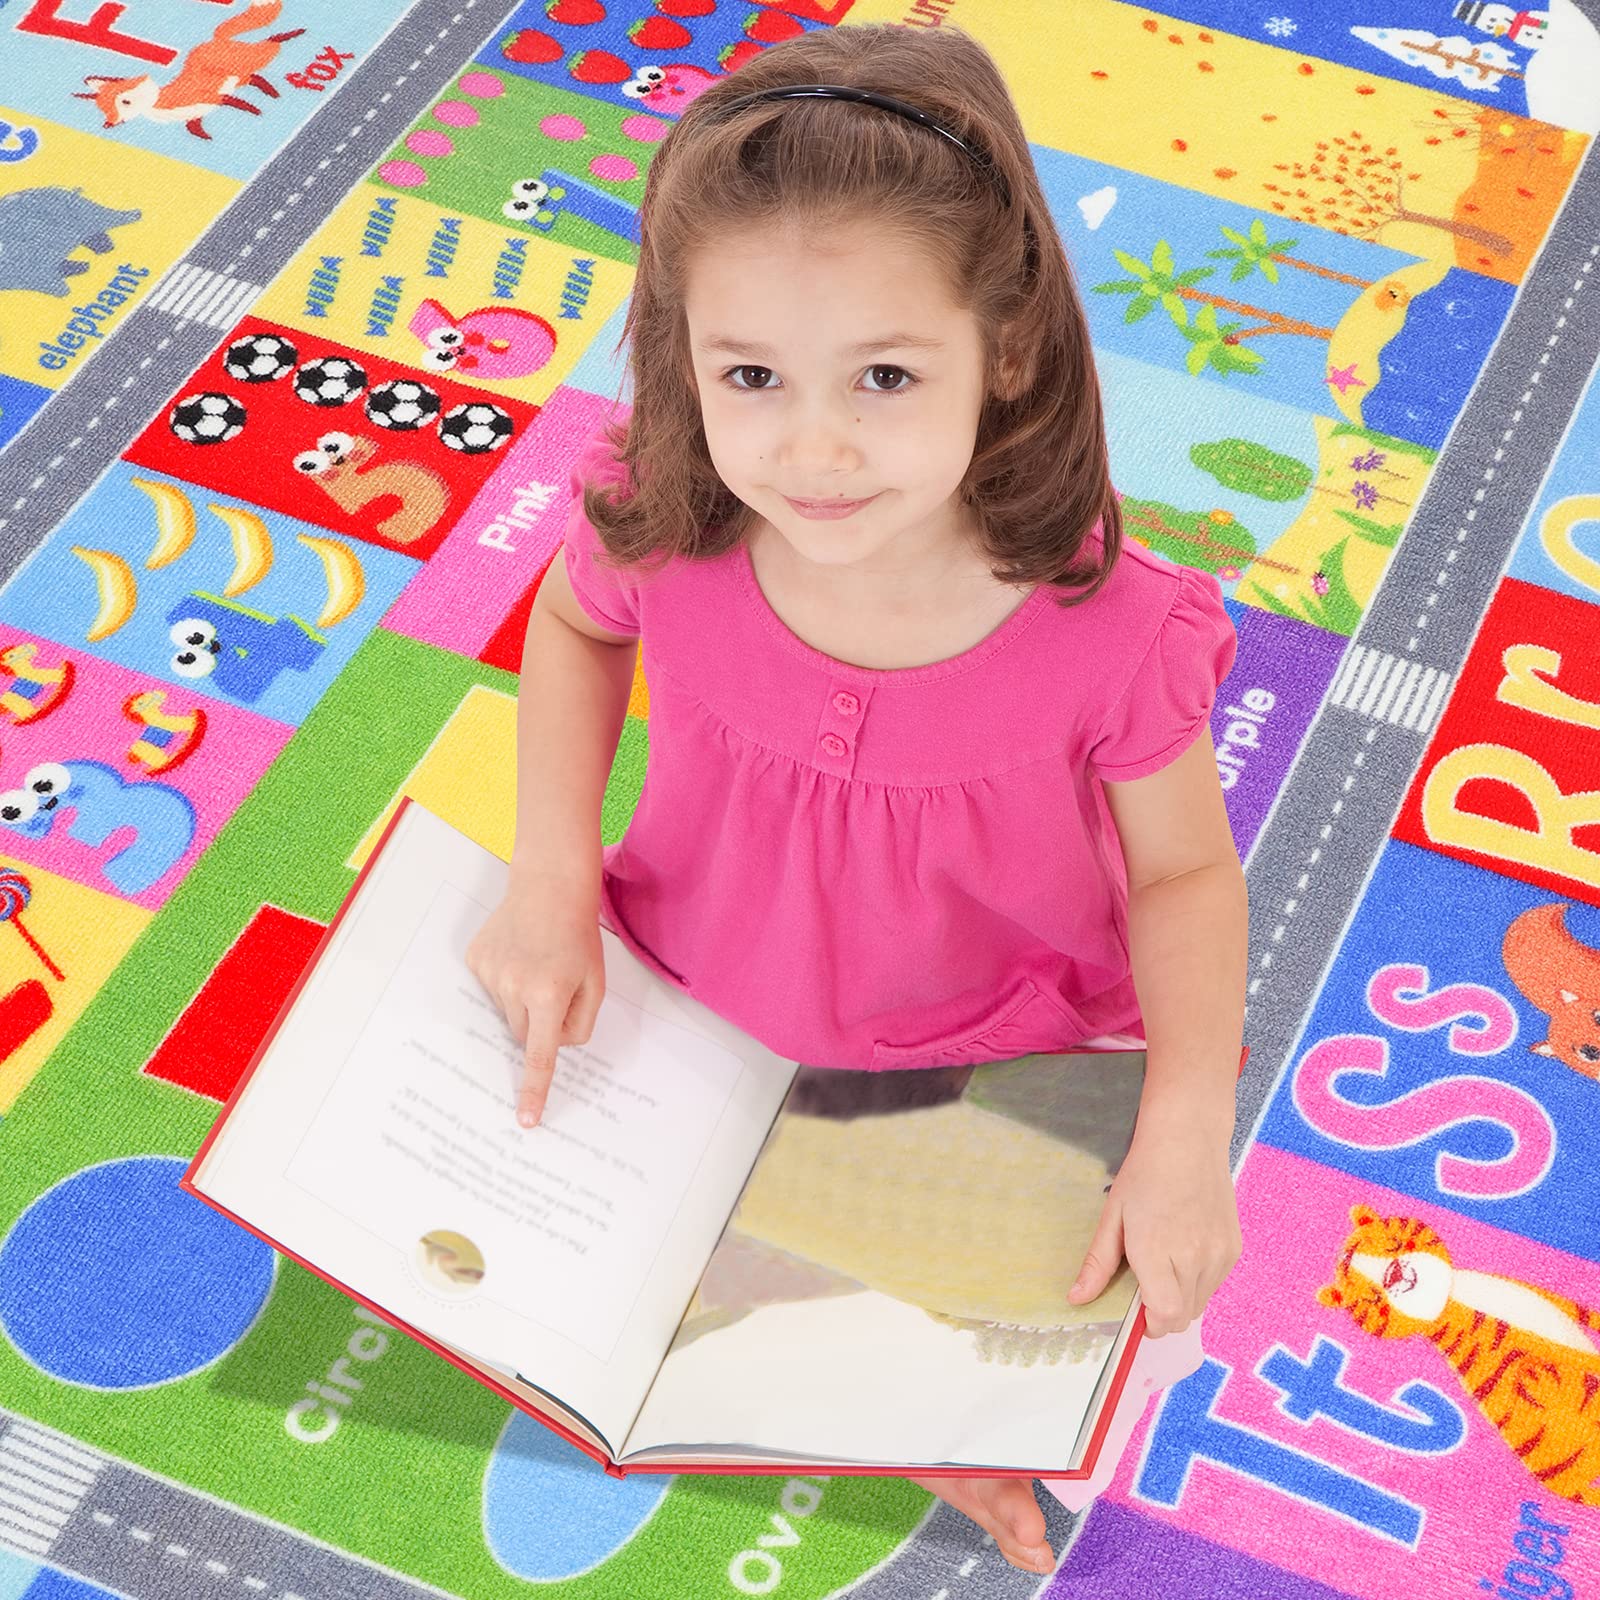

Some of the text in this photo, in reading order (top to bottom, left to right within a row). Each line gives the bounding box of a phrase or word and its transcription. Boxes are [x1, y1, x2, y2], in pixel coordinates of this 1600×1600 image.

[15, 0, 236, 67] F
[284, 45, 356, 92] fox
[38, 263, 150, 371] elephant
[477, 480, 560, 553] Pink
[1214, 687, 1277, 790] urple
[1291, 962, 1557, 1202] Ss
[283, 1304, 398, 1444] Circl
[1128, 1332, 1469, 1552] Tt
[727, 1474, 831, 1597] Ova
[1478, 1500, 1574, 1600] iger
